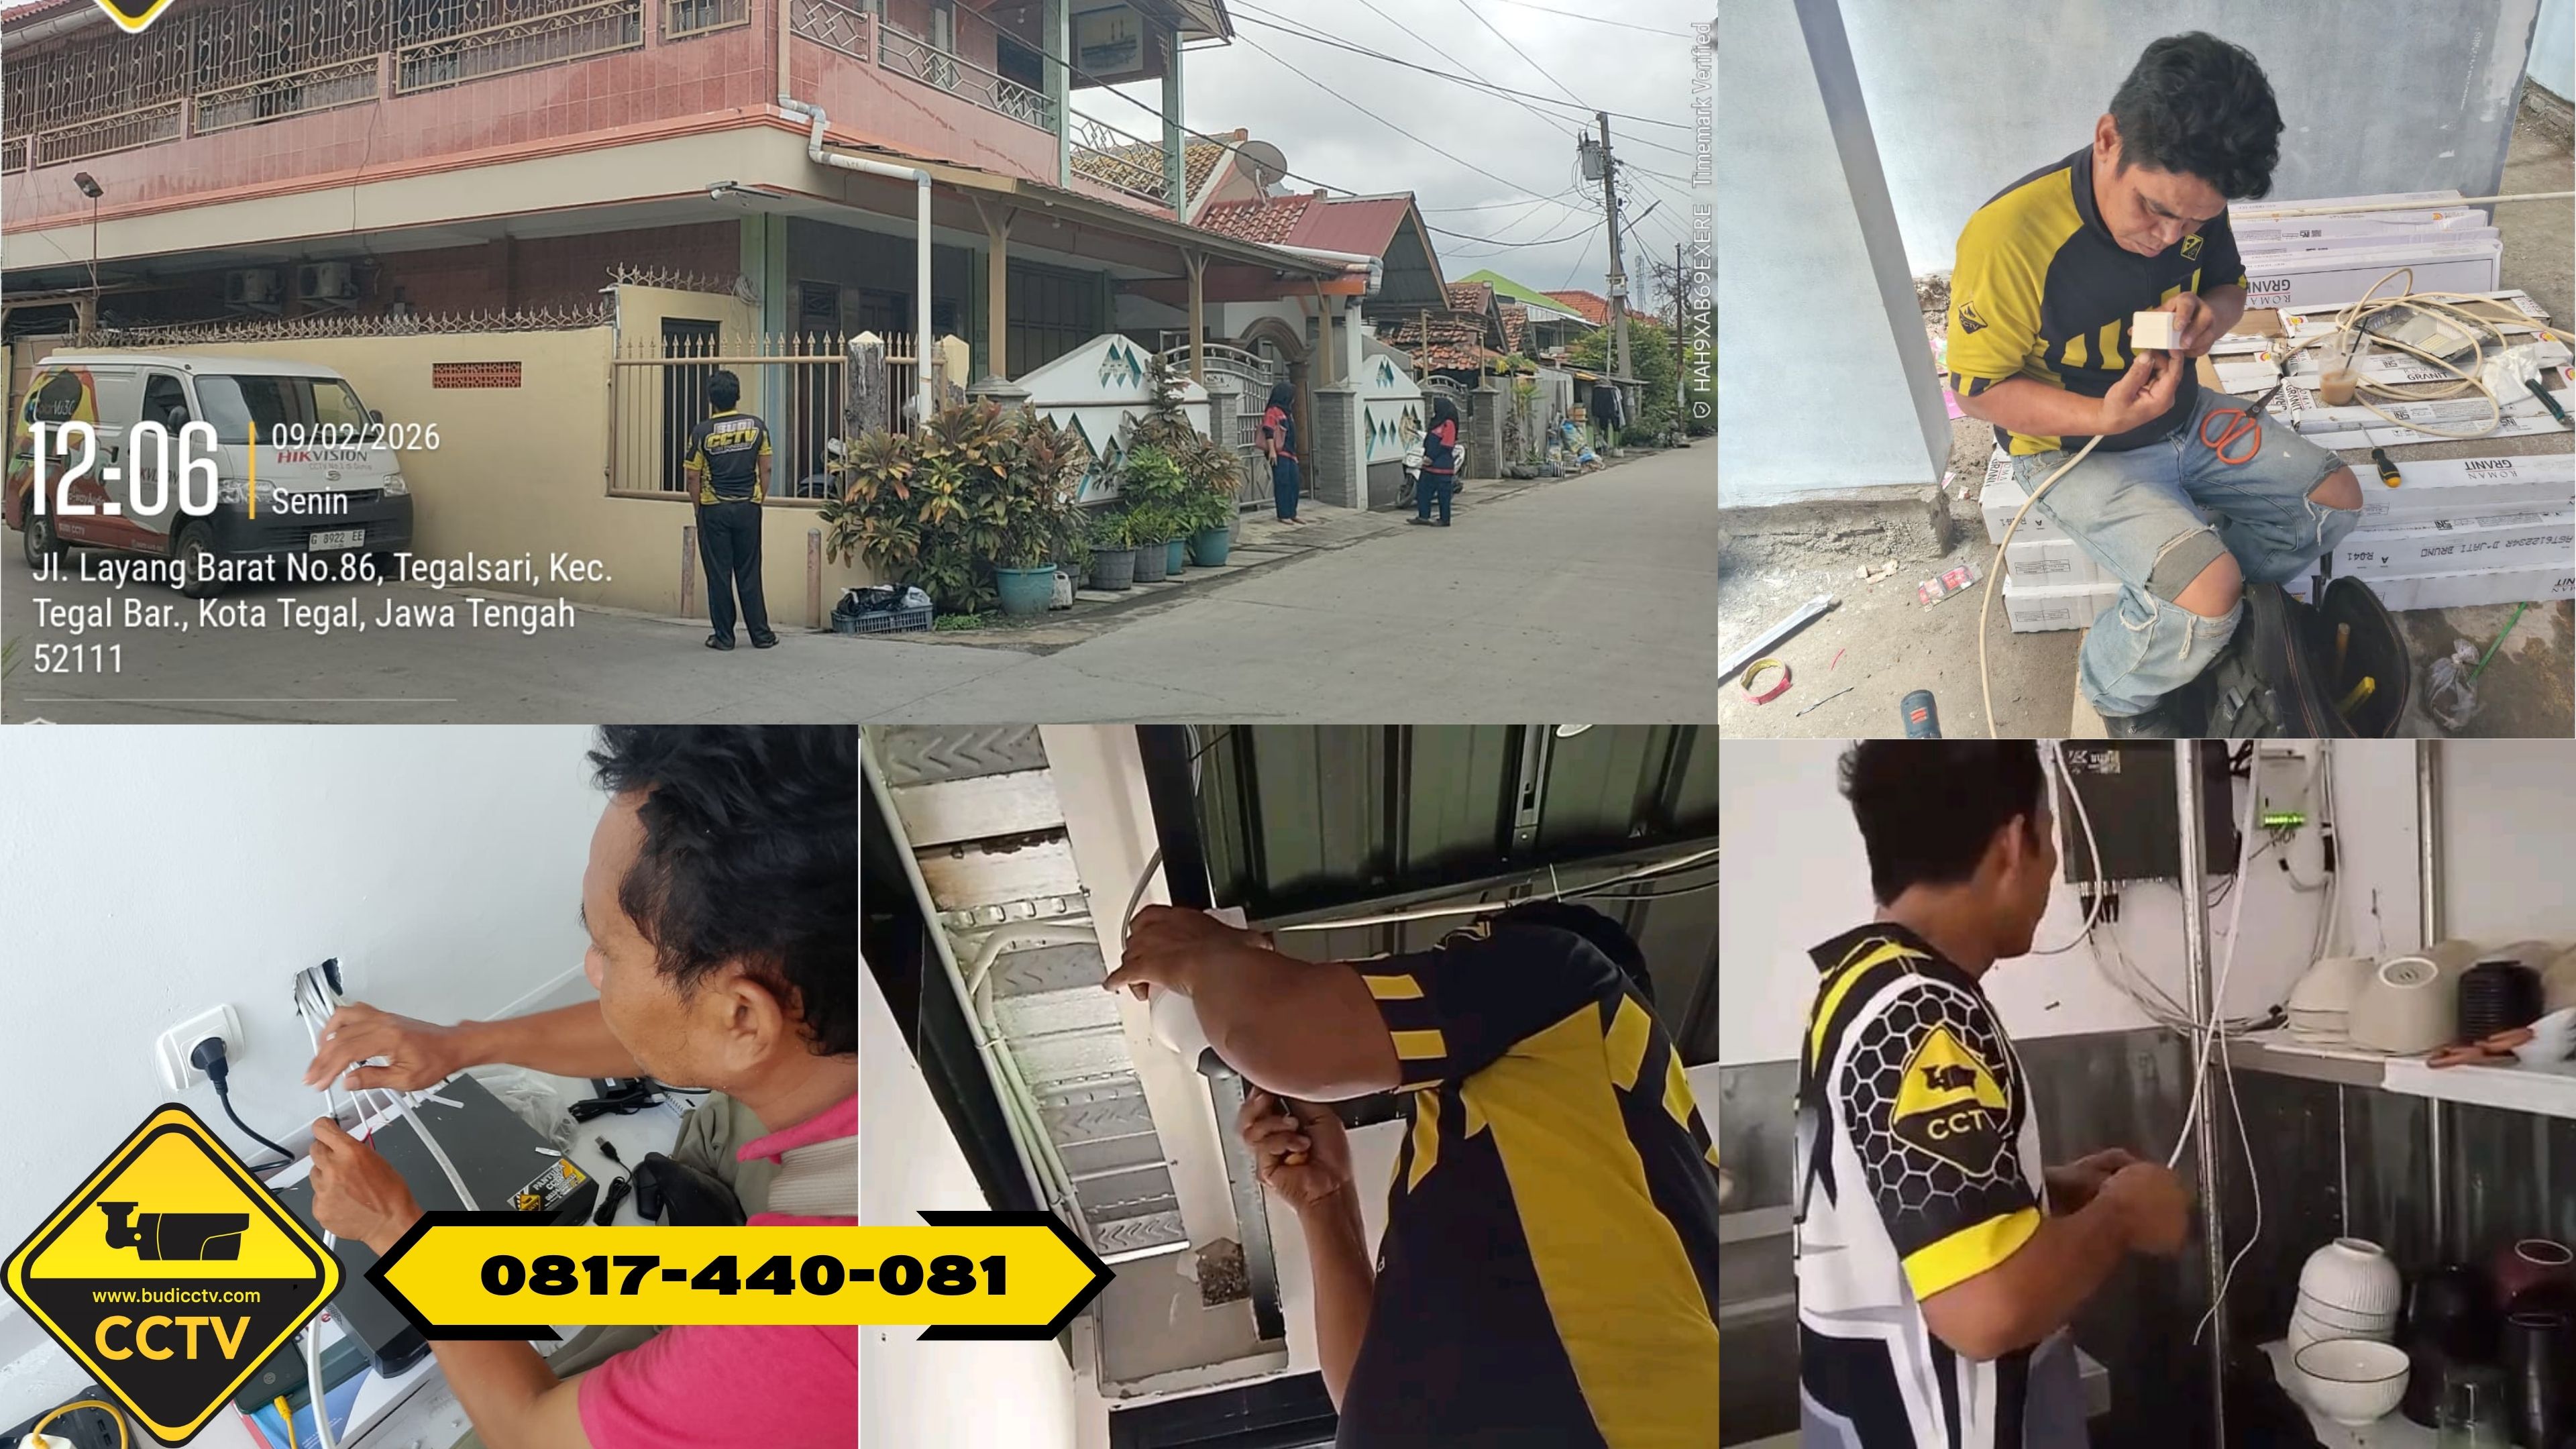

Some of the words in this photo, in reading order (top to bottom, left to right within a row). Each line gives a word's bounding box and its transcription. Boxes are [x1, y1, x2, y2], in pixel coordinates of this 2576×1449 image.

[2247, 279, 2291, 293] GRANI
[2250, 294, 2291, 305] ROMA
[2407, 372, 2448, 380] GRANIT
[707, 429, 757, 448] CCTV
[277, 449, 368, 464] HIKVISION
[2465, 460, 2512, 470] GRANIT
[2468, 470, 2518, 480] ROMAN
[311, 535, 317, 545] G
[323, 533, 345, 544] 8922
[352, 531, 362, 541] EE
